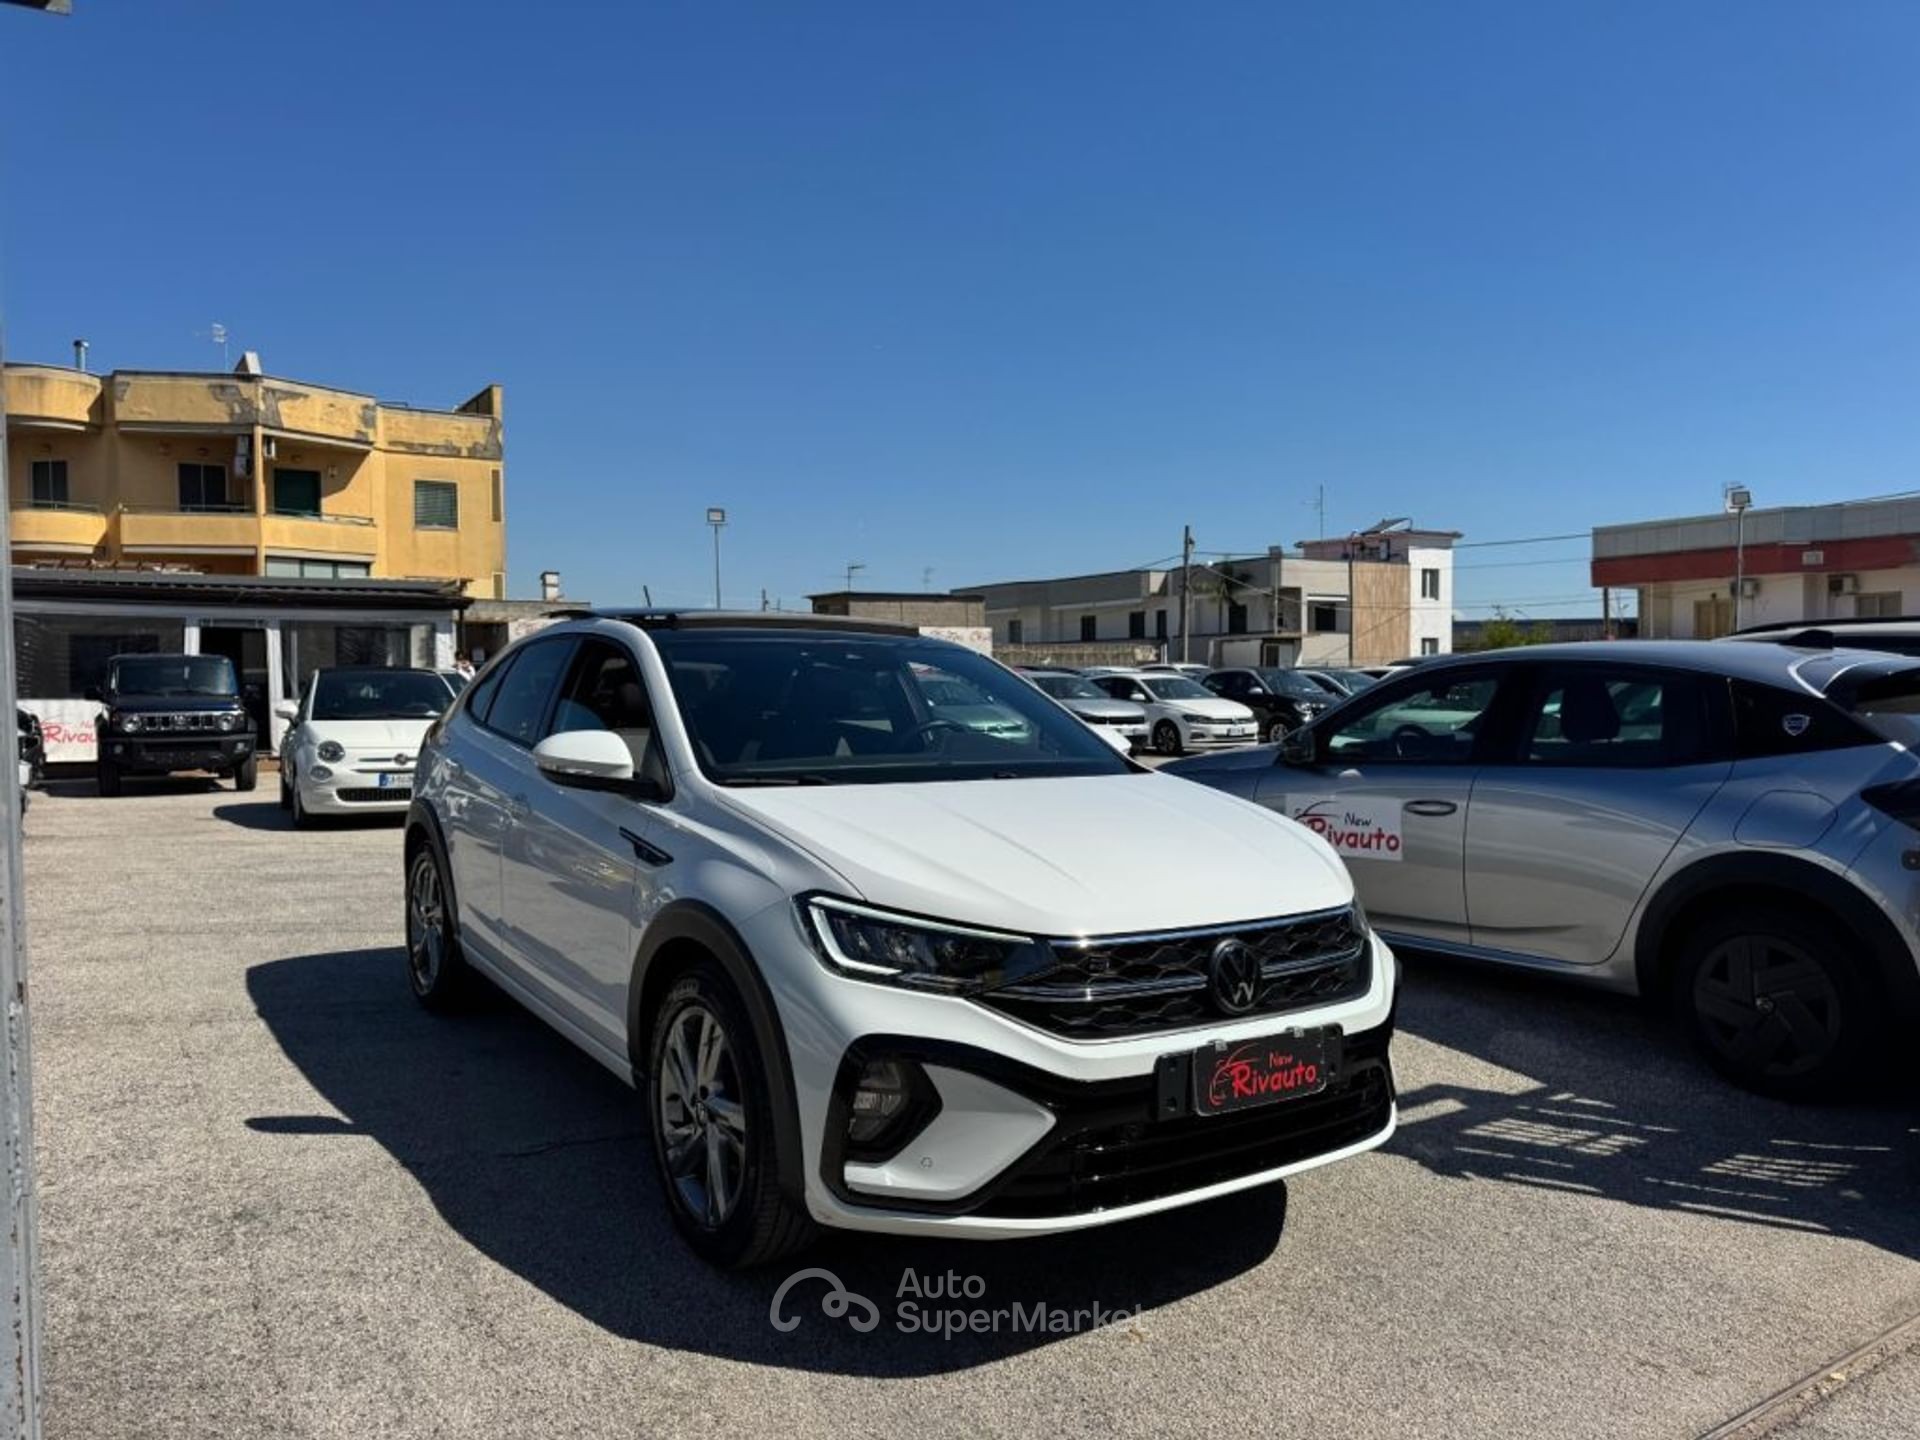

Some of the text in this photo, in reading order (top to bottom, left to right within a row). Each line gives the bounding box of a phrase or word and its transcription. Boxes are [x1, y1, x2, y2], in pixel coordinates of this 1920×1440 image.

[43, 725, 97, 744] Rivau
[1344, 812, 1372, 826] New
[1269, 1053, 1293, 1068] New
[1231, 1059, 1317, 1097] Rivauto
